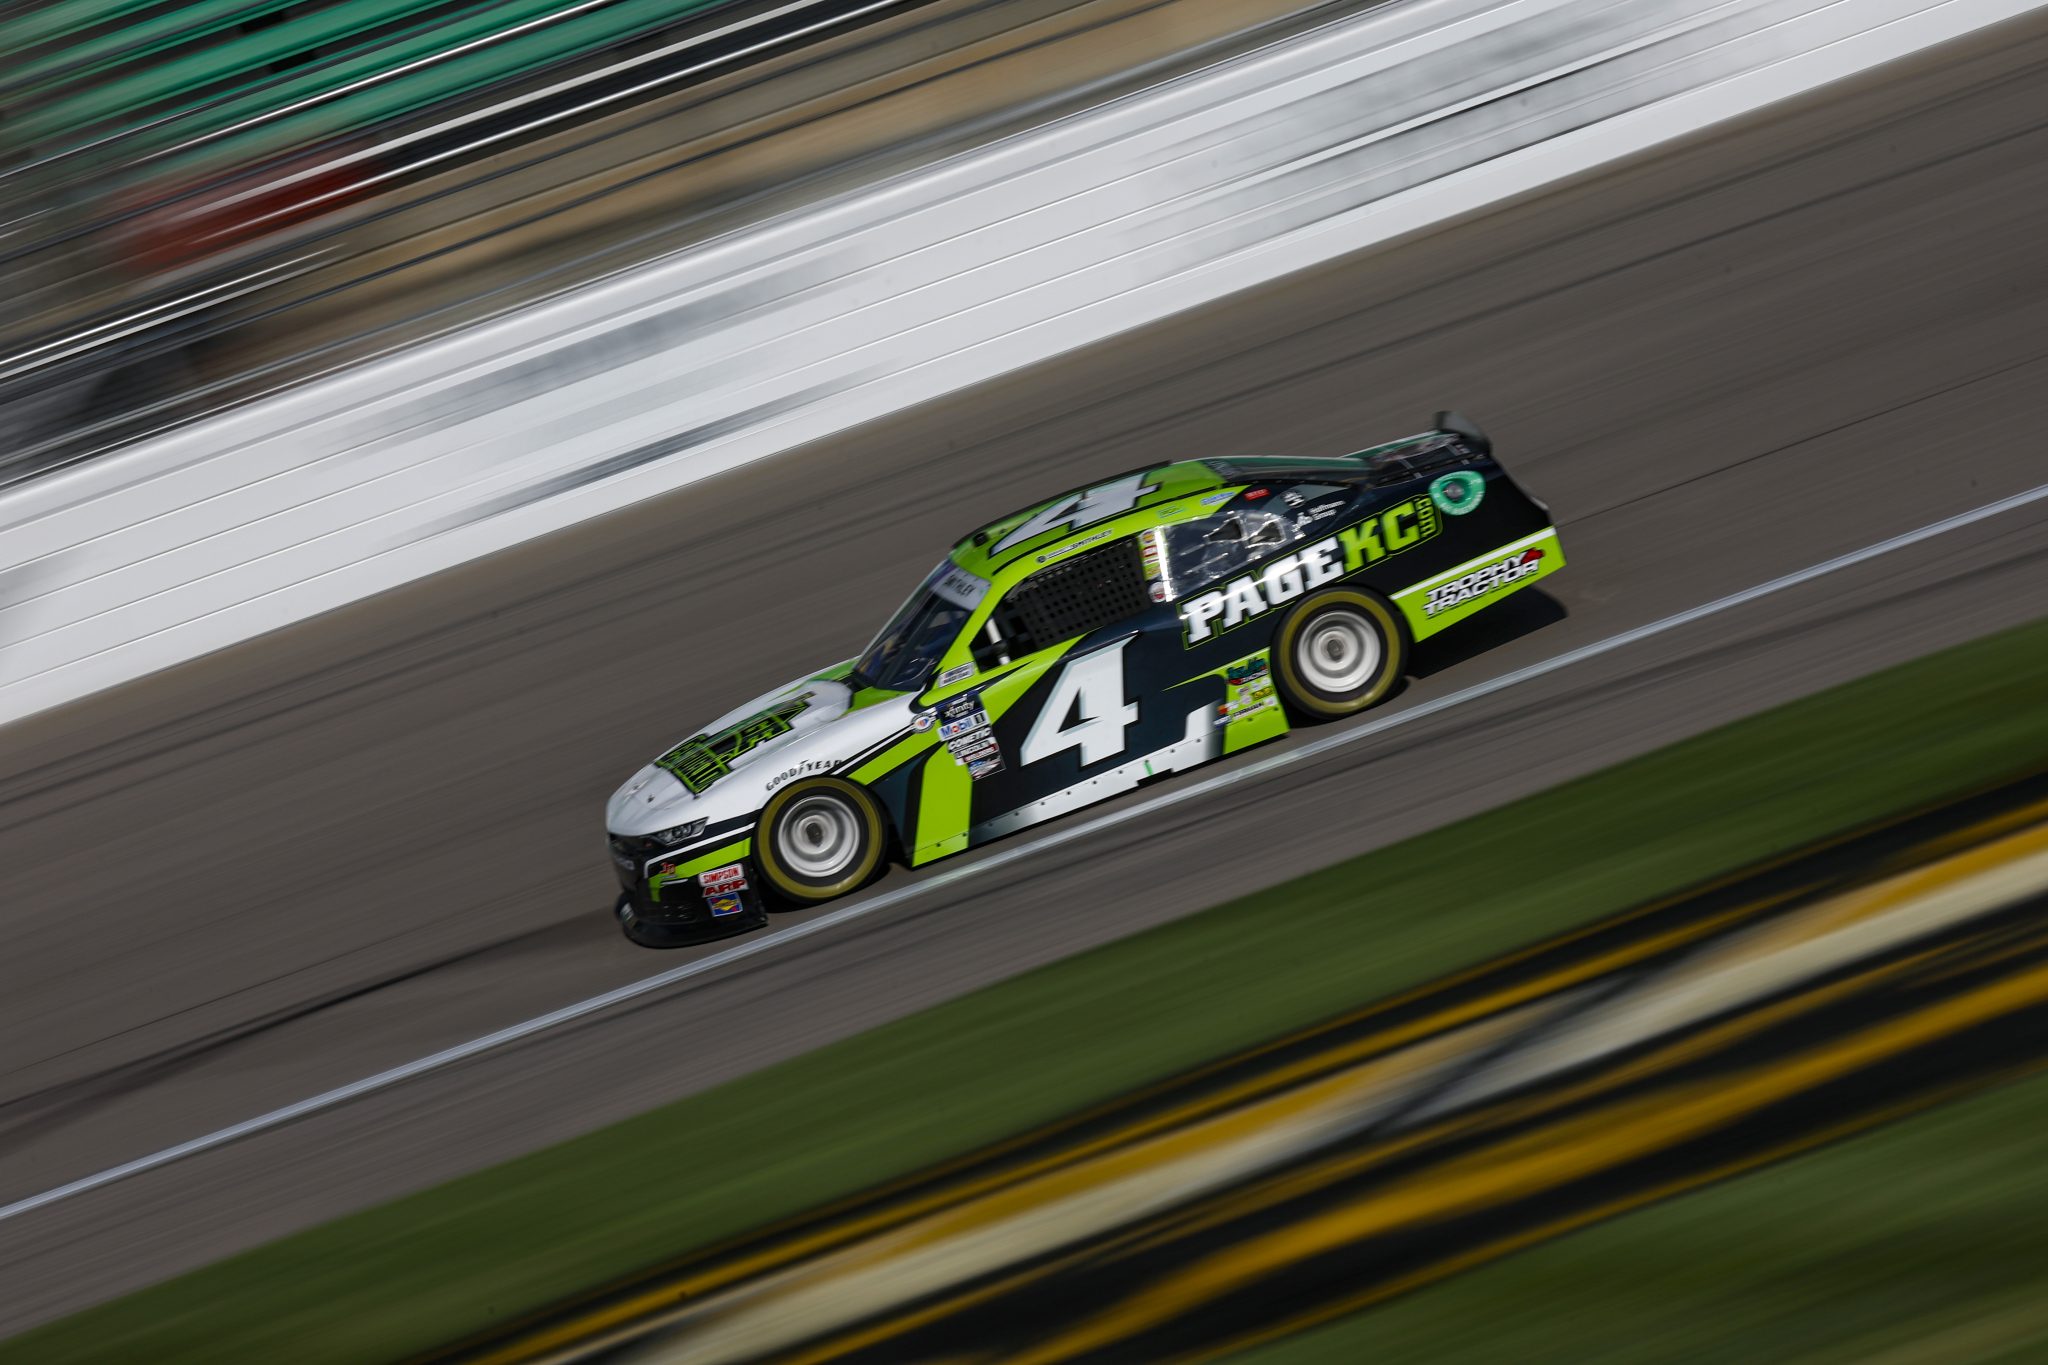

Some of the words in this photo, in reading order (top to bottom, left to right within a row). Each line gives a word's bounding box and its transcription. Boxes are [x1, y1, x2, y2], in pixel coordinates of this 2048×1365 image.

[989, 473, 1161, 559] 4
[1423, 559, 1540, 617] TRACTOR
[1425, 551, 1529, 601] TROPHY
[940, 717, 973, 737] Mobil
[1020, 636, 1139, 768] 4
[703, 867, 739, 884] SIMPSON
[704, 879, 745, 896] ARP
